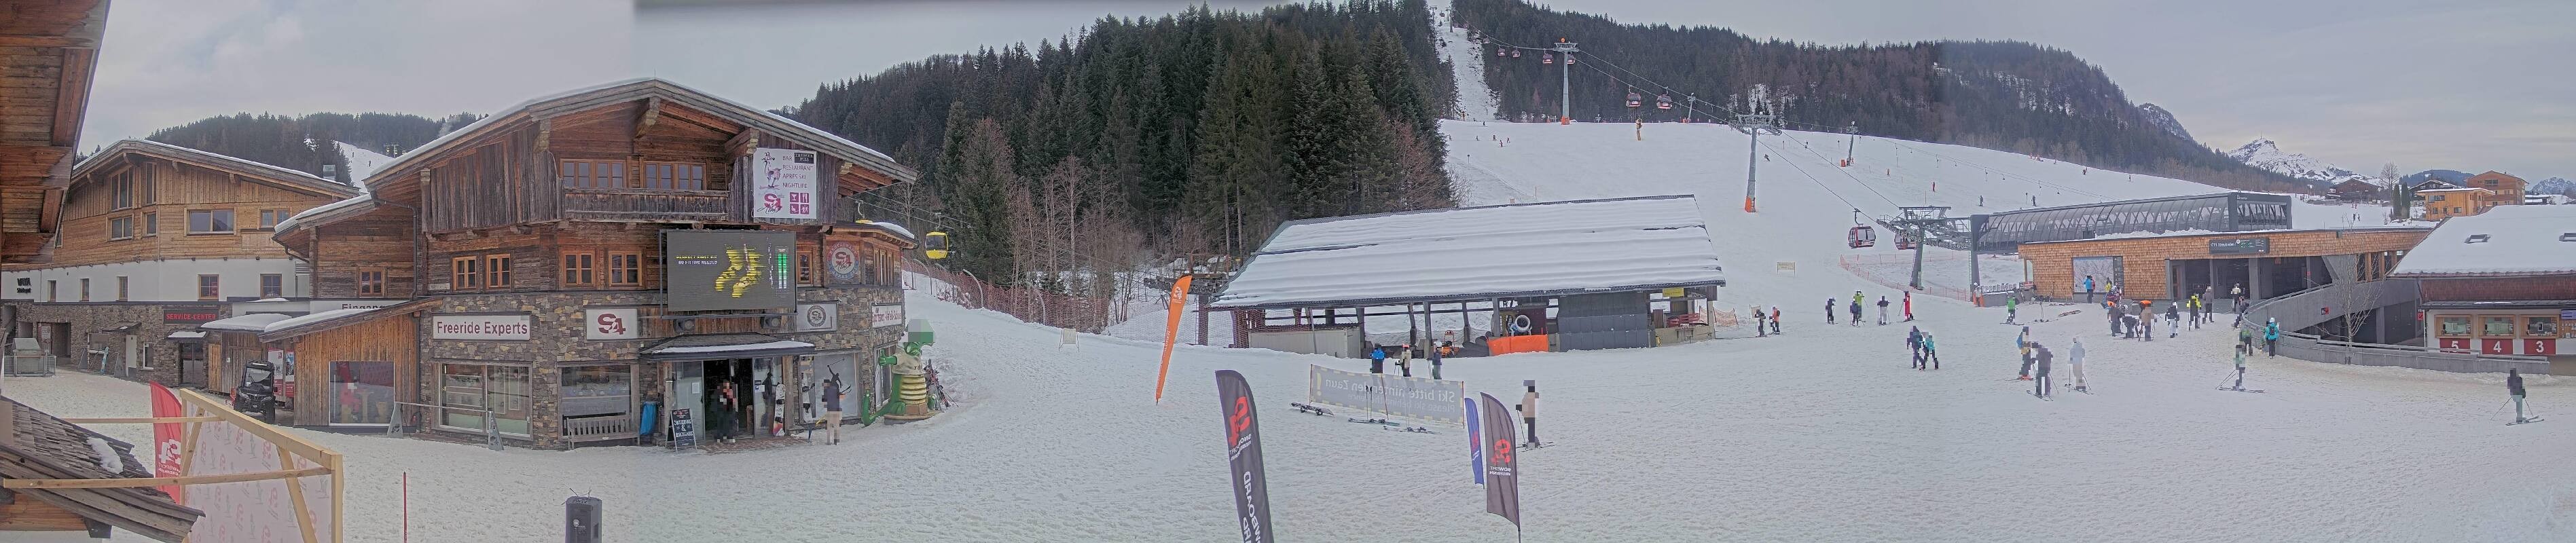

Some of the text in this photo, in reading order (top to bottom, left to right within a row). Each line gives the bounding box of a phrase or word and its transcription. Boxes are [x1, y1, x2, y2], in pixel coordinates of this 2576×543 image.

[437, 321, 528, 336] Freeride Experts
[598, 313, 626, 335] S4
[2451, 341, 2459, 352] 5
[2493, 341, 2502, 353] 4
[2535, 340, 2545, 353] 3
